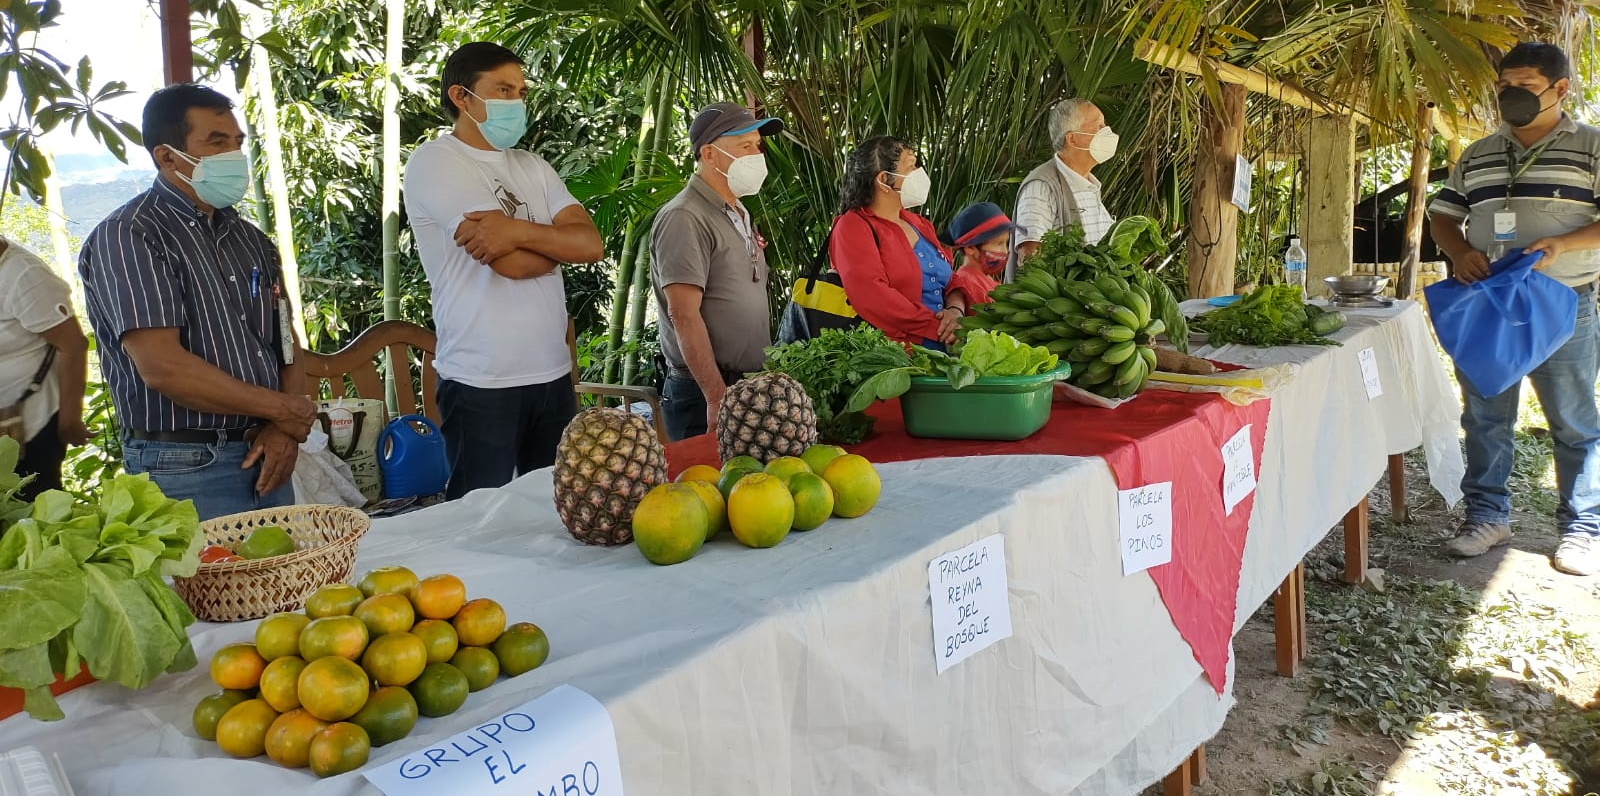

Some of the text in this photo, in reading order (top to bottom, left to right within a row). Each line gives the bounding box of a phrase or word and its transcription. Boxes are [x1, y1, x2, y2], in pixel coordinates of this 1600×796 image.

[1128, 490, 1164, 509] PARCELA
[1136, 513, 1154, 529] LOS
[1127, 533, 1164, 555] PINOS
[938, 546, 989, 584] PARCELA
[947, 576, 983, 605] REYNA
[957, 601, 979, 626] DEL
[945, 616, 990, 658] BOSQUE
[399, 712, 536, 779] GRUPO
[483, 749, 527, 785] EL
